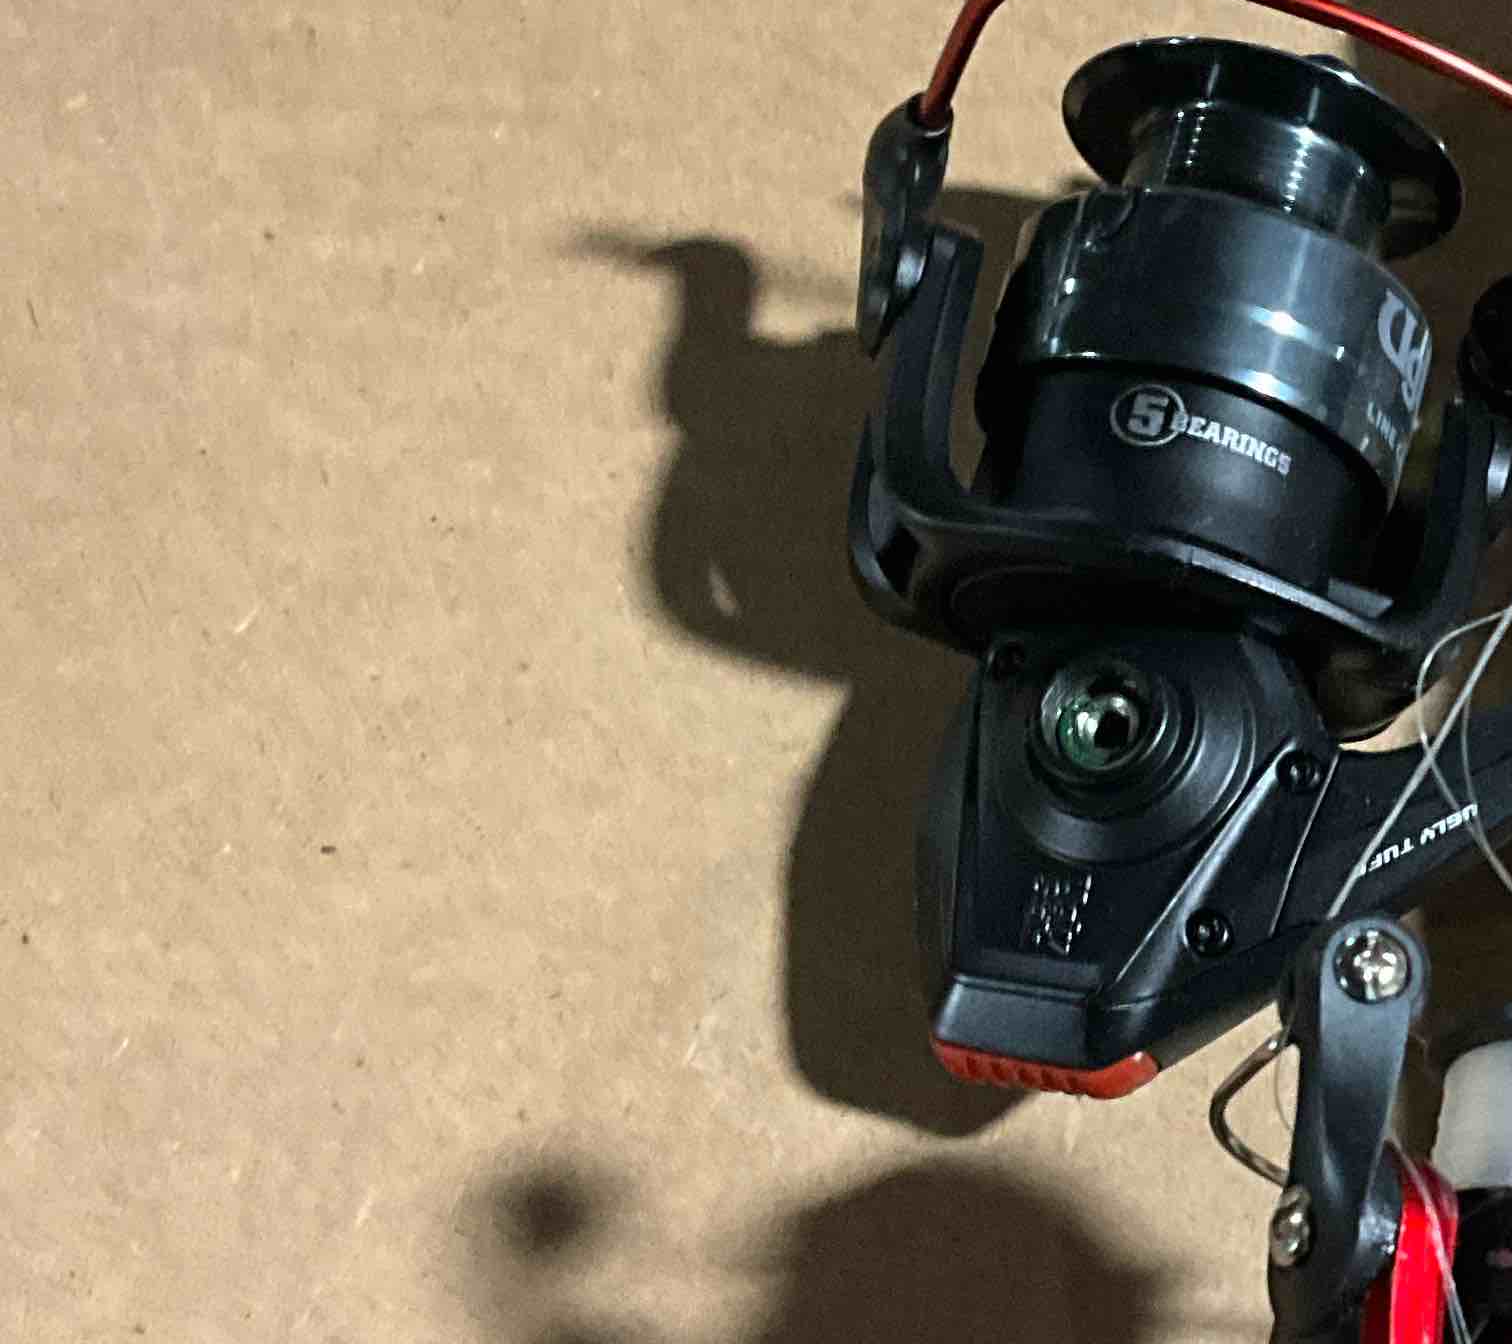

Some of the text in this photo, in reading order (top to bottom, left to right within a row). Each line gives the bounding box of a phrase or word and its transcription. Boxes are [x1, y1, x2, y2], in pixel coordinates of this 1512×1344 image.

[1126, 392, 1292, 476] 5 BEARINGS
[1420, 803, 1478, 845] UGLY
